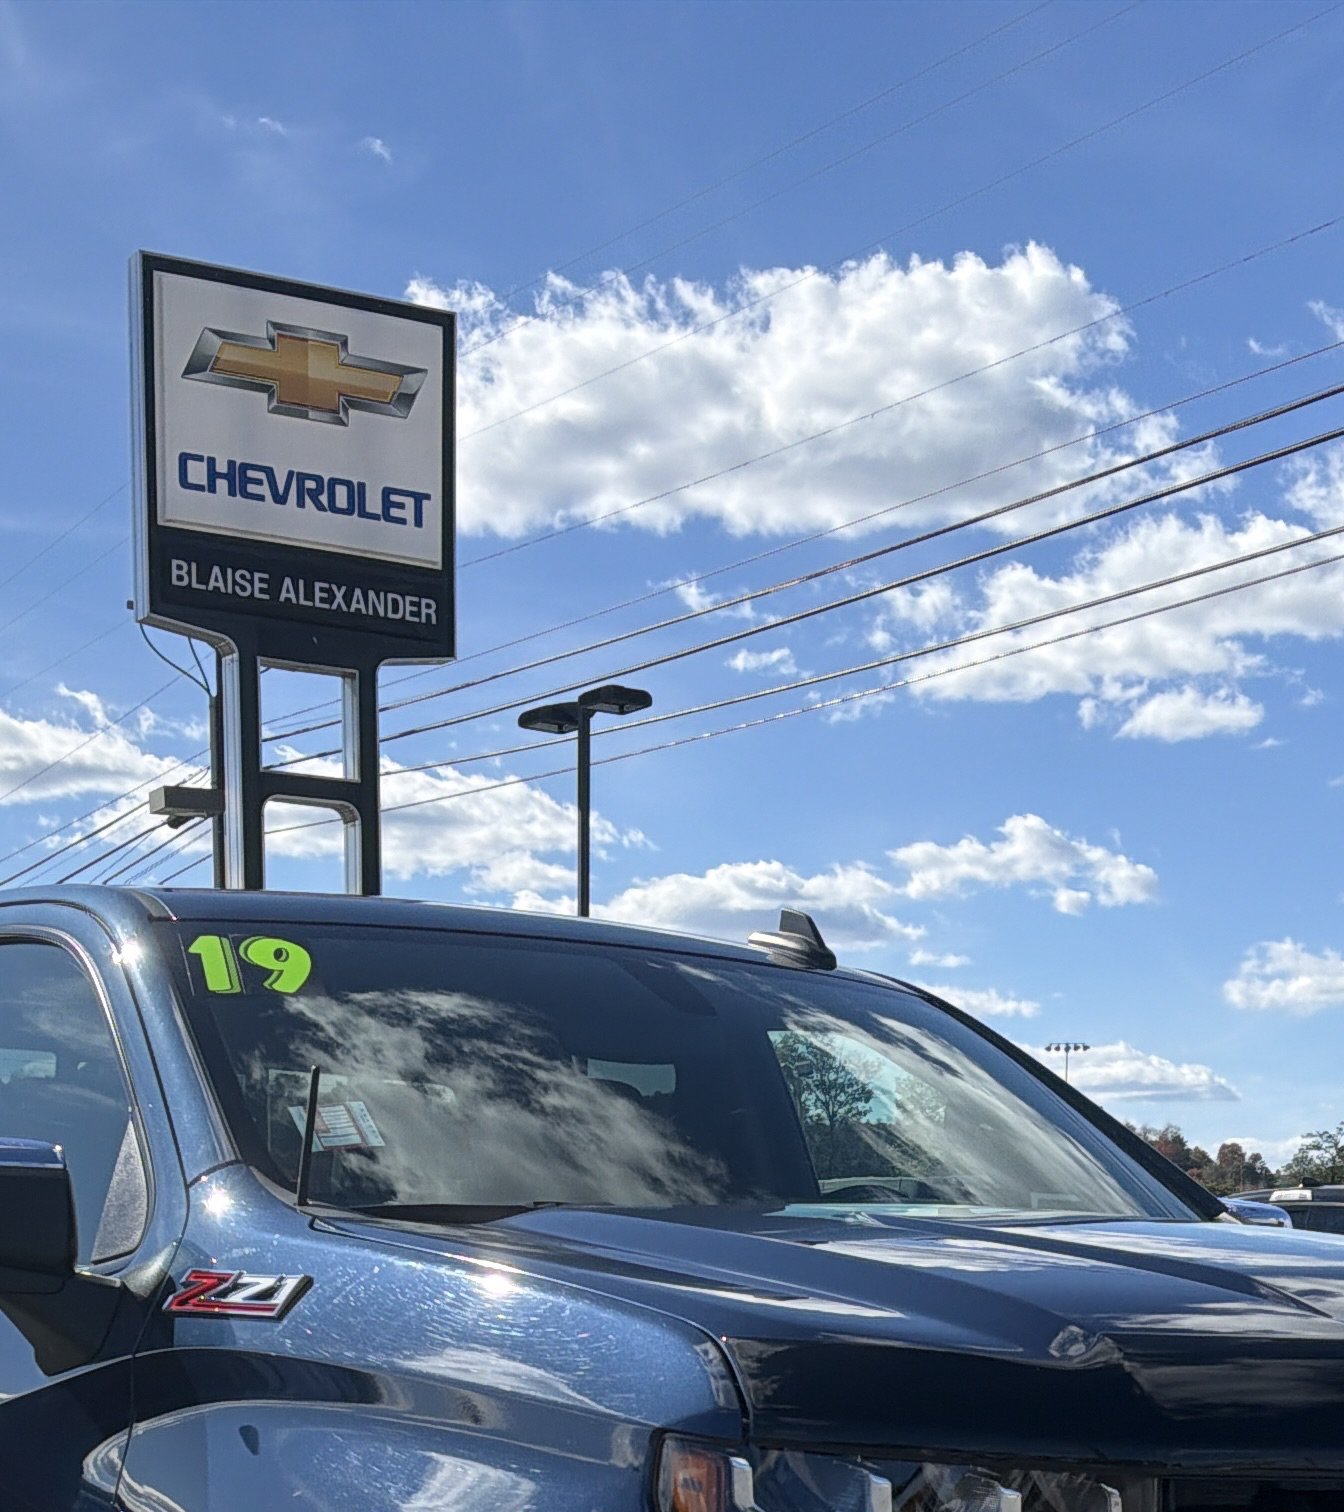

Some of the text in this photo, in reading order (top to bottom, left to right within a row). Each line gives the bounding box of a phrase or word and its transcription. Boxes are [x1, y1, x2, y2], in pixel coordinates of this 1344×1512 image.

[178, 452, 432, 528] CHEVROLET
[171, 559, 438, 625] BLAISE ALEXANDER
[187, 935, 312, 994] 19
[162, 1268, 314, 1322] Z71
